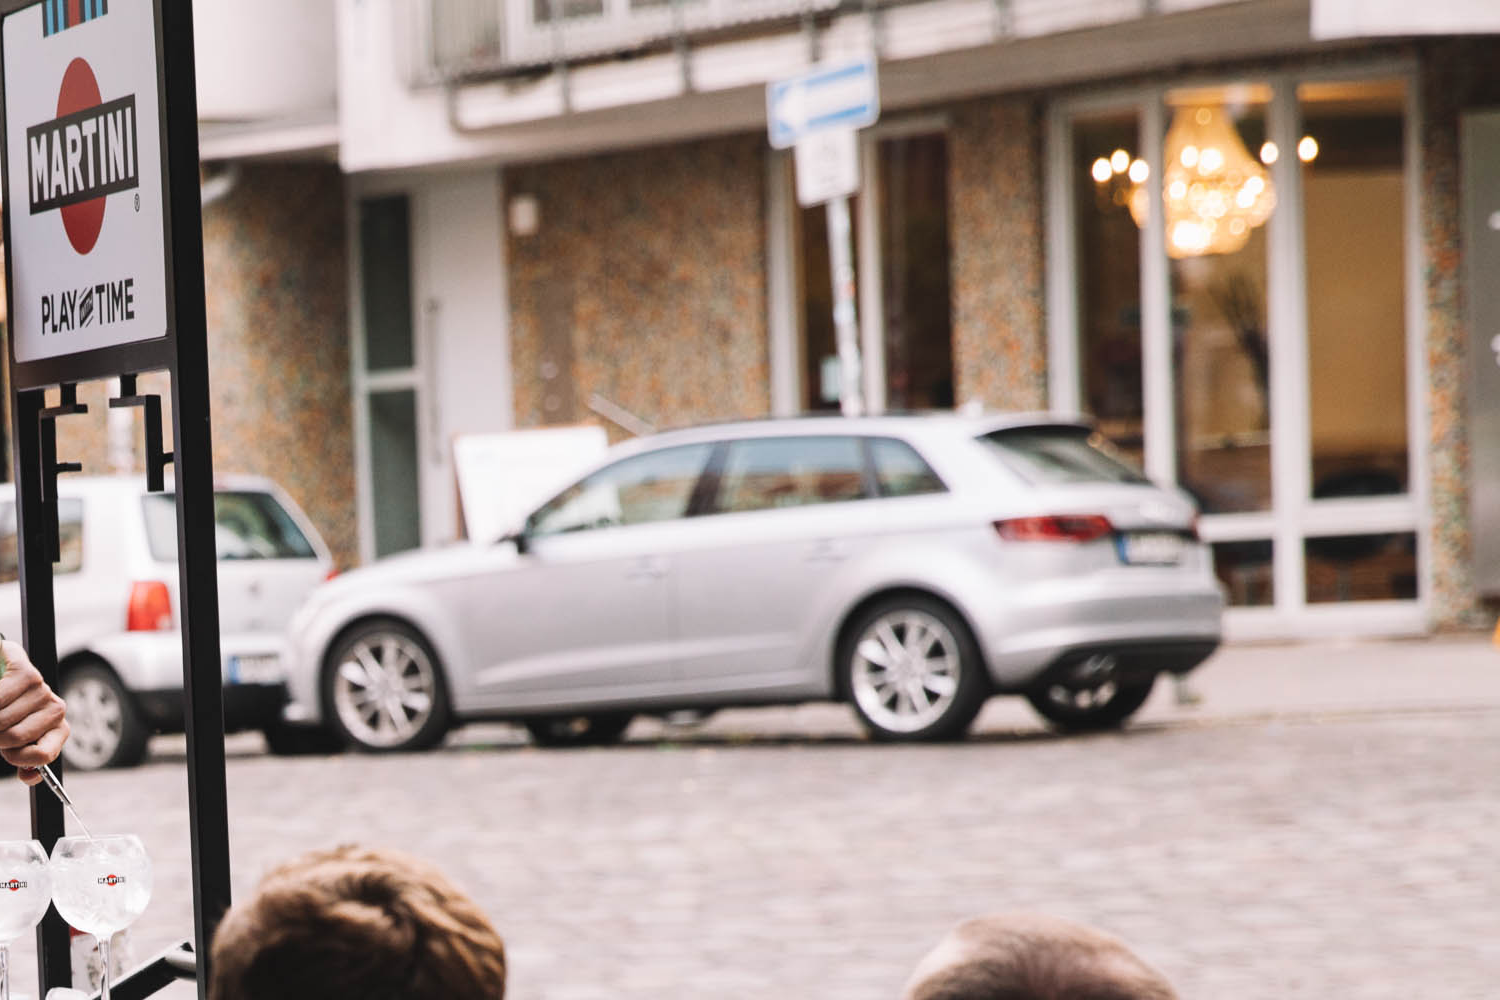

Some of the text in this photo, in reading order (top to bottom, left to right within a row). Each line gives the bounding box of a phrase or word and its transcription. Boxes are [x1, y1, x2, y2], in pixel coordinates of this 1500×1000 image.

[30, 106, 135, 204] MARTINI
[41, 289, 78, 335] PLAY
[95, 278, 134, 325] TIME
